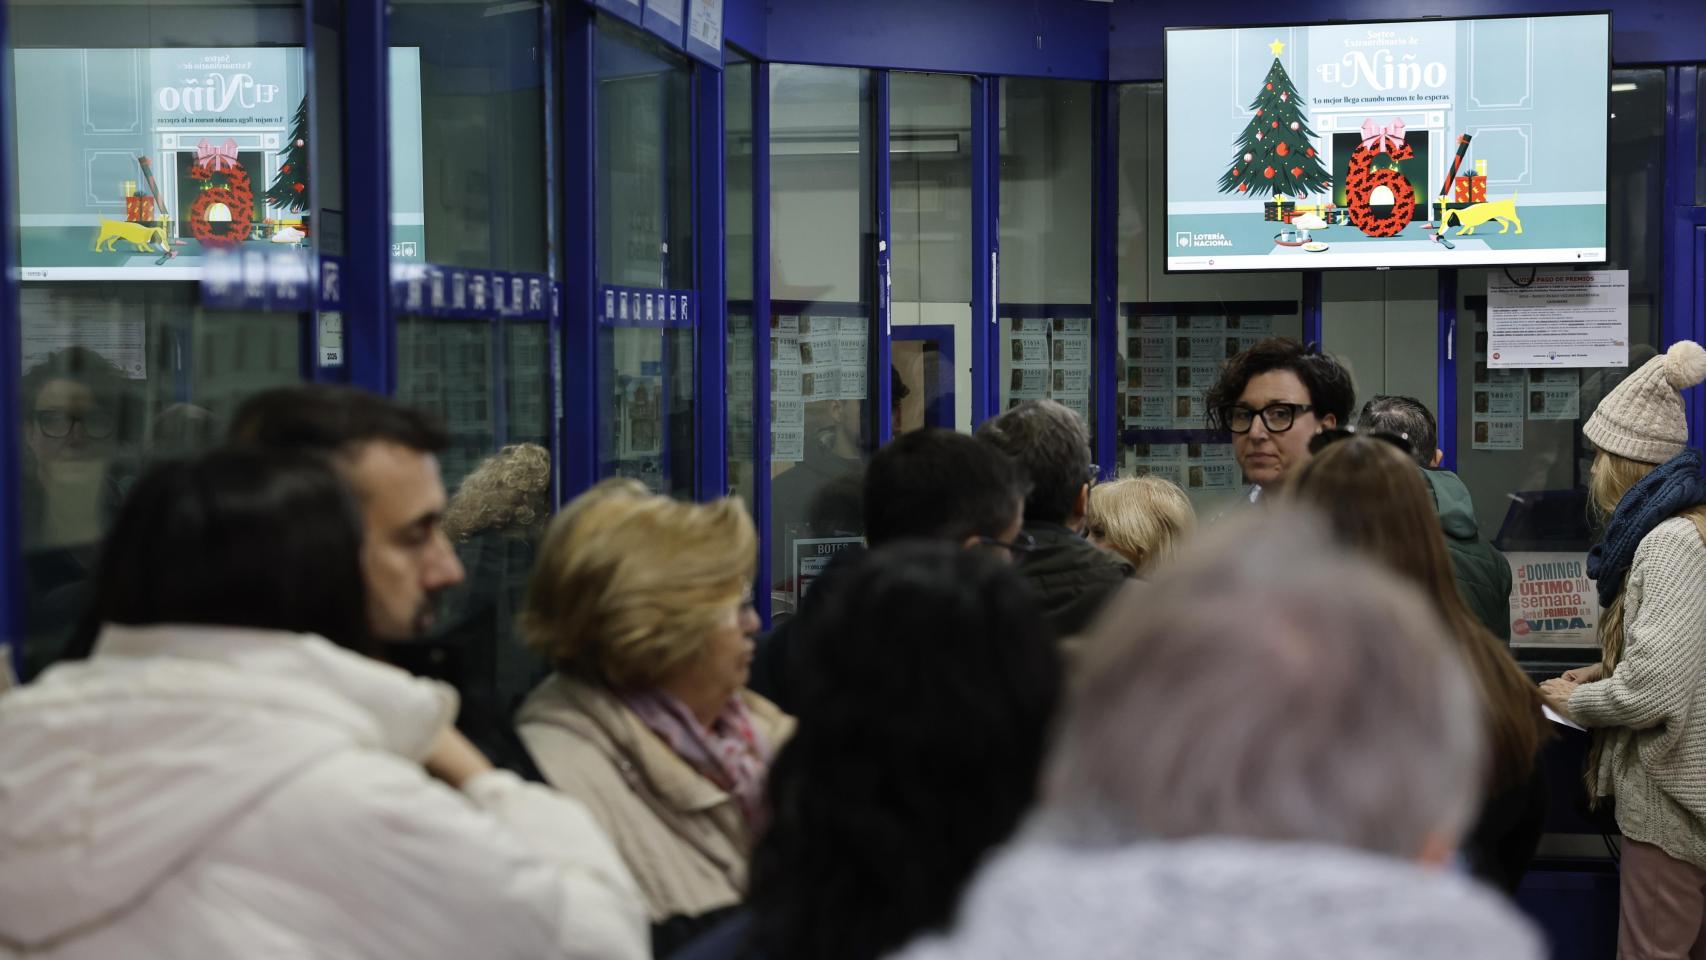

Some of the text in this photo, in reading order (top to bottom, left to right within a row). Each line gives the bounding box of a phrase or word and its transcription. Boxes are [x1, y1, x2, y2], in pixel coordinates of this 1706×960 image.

[1367, 30, 1395, 40] Sorteo
[1316, 48, 1448, 92] El Niño
[1323, 97, 1342, 105] mejor
[1360, 95, 1385, 103] cuando
[1424, 94, 1449, 102] esperas
[1193, 232, 1225, 240] LOTERÍA
[1566, 275, 1595, 283] PREMIOS
[1526, 561, 1582, 581] DOMINGO
[1520, 580, 1574, 596] ÚLTIMO
[1576, 576, 1591, 592] DÍA
[1521, 594, 1586, 608] semana.
[1544, 607, 1578, 618] PRIMERO
